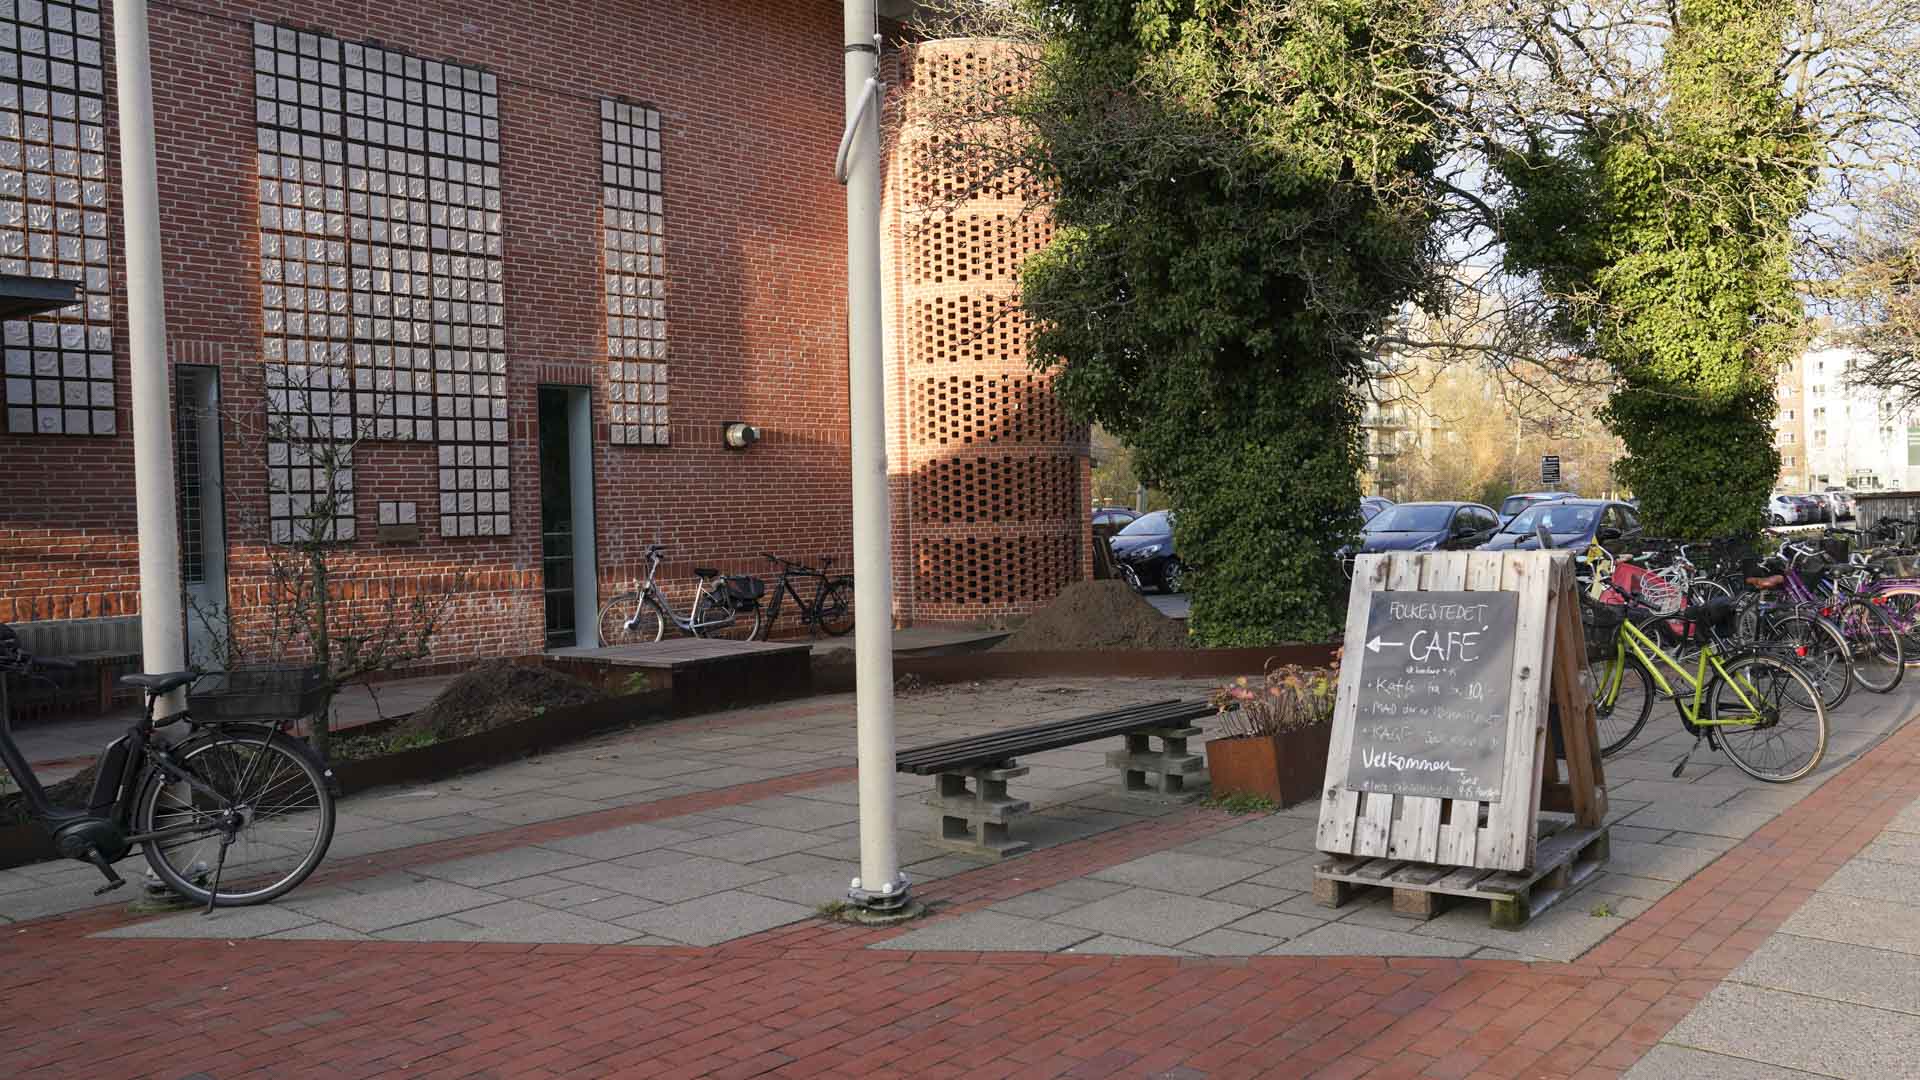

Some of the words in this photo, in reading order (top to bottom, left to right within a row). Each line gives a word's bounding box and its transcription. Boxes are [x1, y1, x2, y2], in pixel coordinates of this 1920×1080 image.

[1390, 601, 1489, 623] FOLKESTEDET
[1409, 625, 1489, 662] CAFÉ
[1362, 746, 1451, 771] Velkommen
